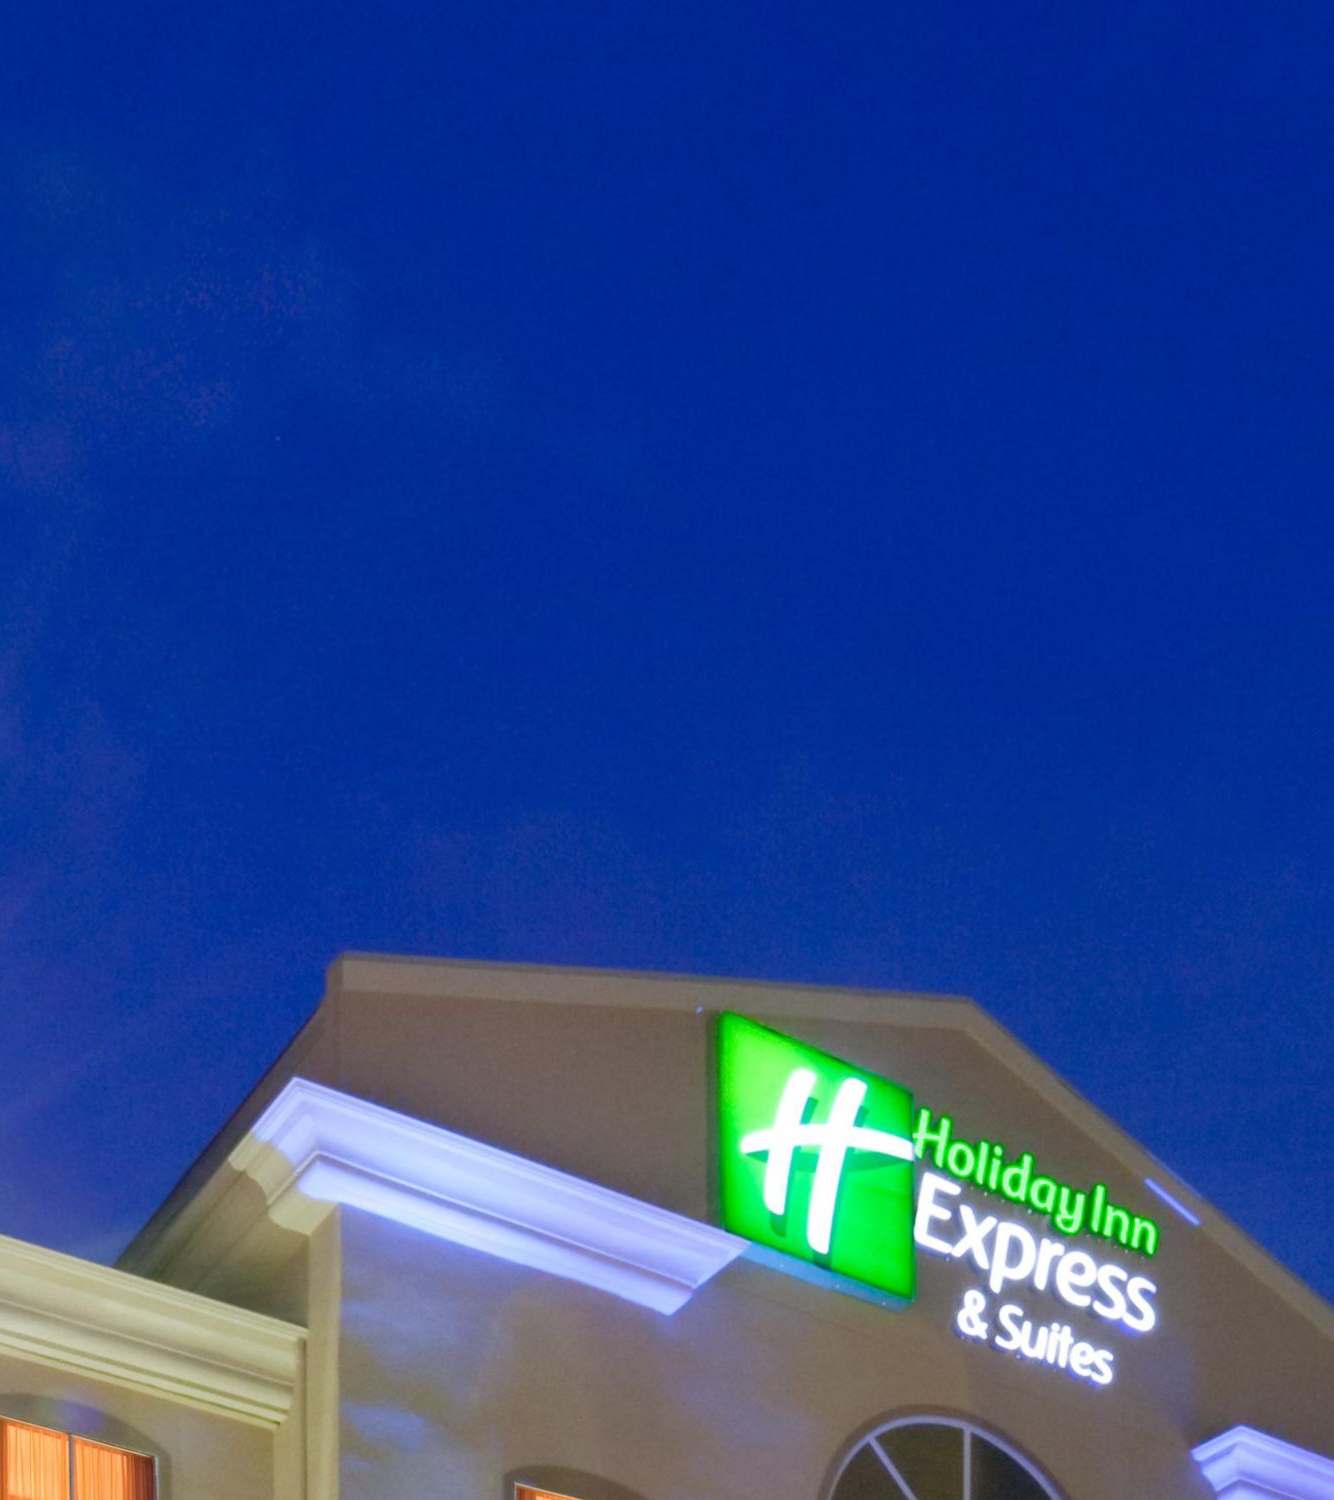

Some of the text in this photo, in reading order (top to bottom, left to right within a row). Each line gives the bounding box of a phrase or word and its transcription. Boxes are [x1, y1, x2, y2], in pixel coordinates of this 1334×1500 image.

[912, 1107, 1159, 1257] Holiday Inn
[913, 1171, 1157, 1332] Express
[956, 1289, 1114, 1385] & Suites
